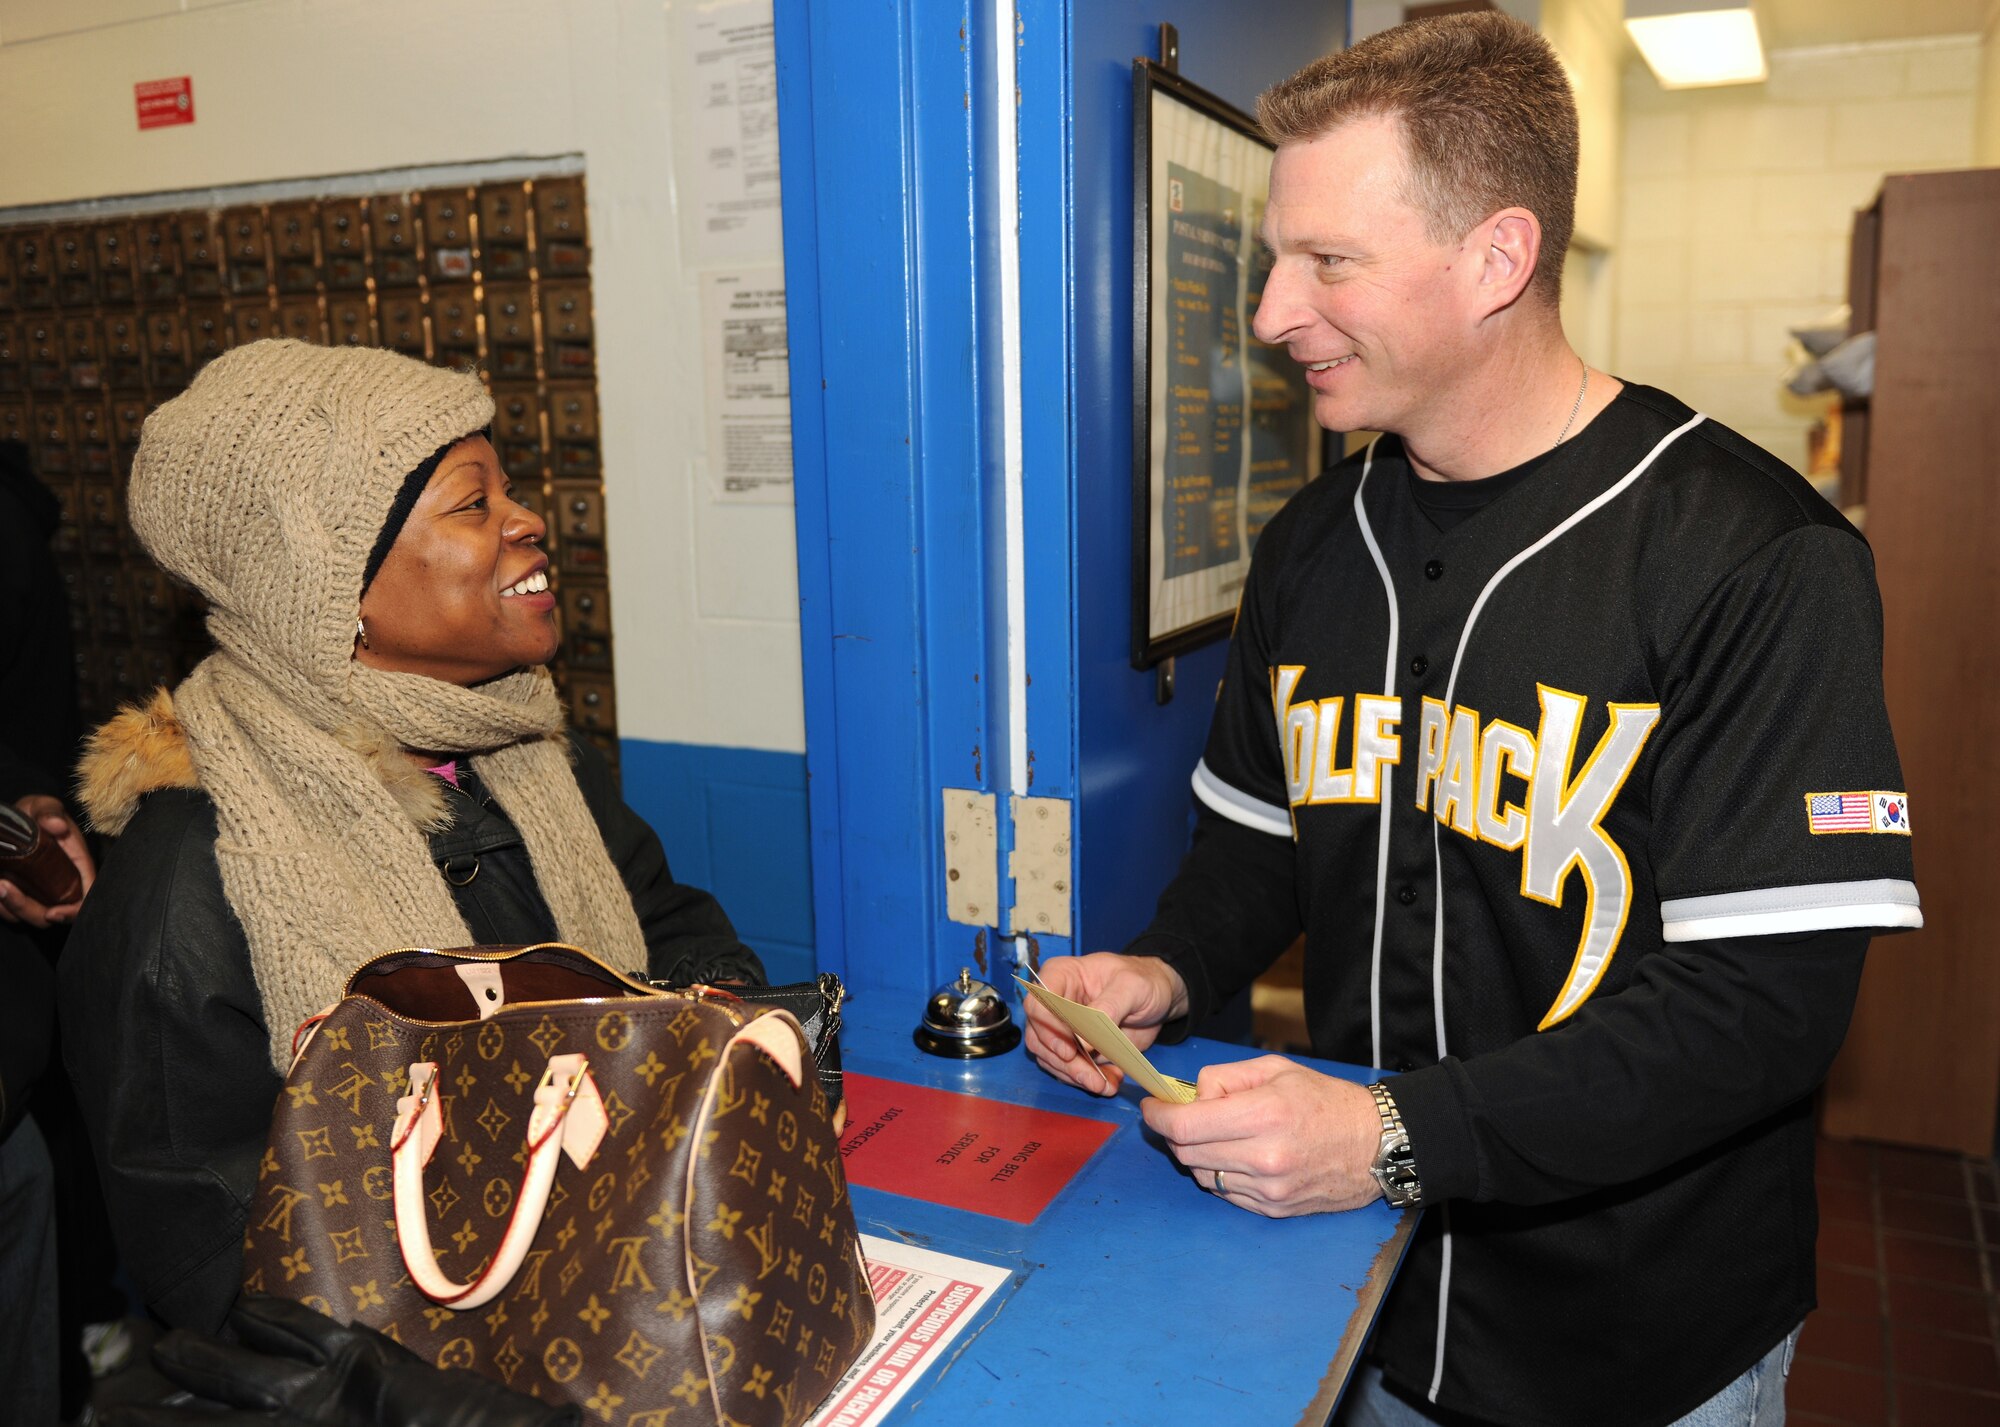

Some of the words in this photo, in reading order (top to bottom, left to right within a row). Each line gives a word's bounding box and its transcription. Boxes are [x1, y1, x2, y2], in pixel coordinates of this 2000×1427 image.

[1415, 682, 1661, 1032] PACK
[880, 1107, 903, 1122] 100
[840, 1121, 885, 1158] PERCENT
[936, 1132, 979, 1165] SERVICE
[974, 1146, 1000, 1164] FOR
[1012, 1141, 1042, 1163] RING
[990, 1163, 1019, 1182] BELL
[914, 1290, 936, 1308] Protect
[893, 1307, 918, 1330] yourself,
[910, 1284, 974, 1343] SUSPICIOUS
[883, 1328, 898, 1344] your
[858, 1343, 887, 1368] business,
[884, 1342, 923, 1368] MAIL
[847, 1368, 861, 1380] and
[868, 1369, 897, 1387] OR
